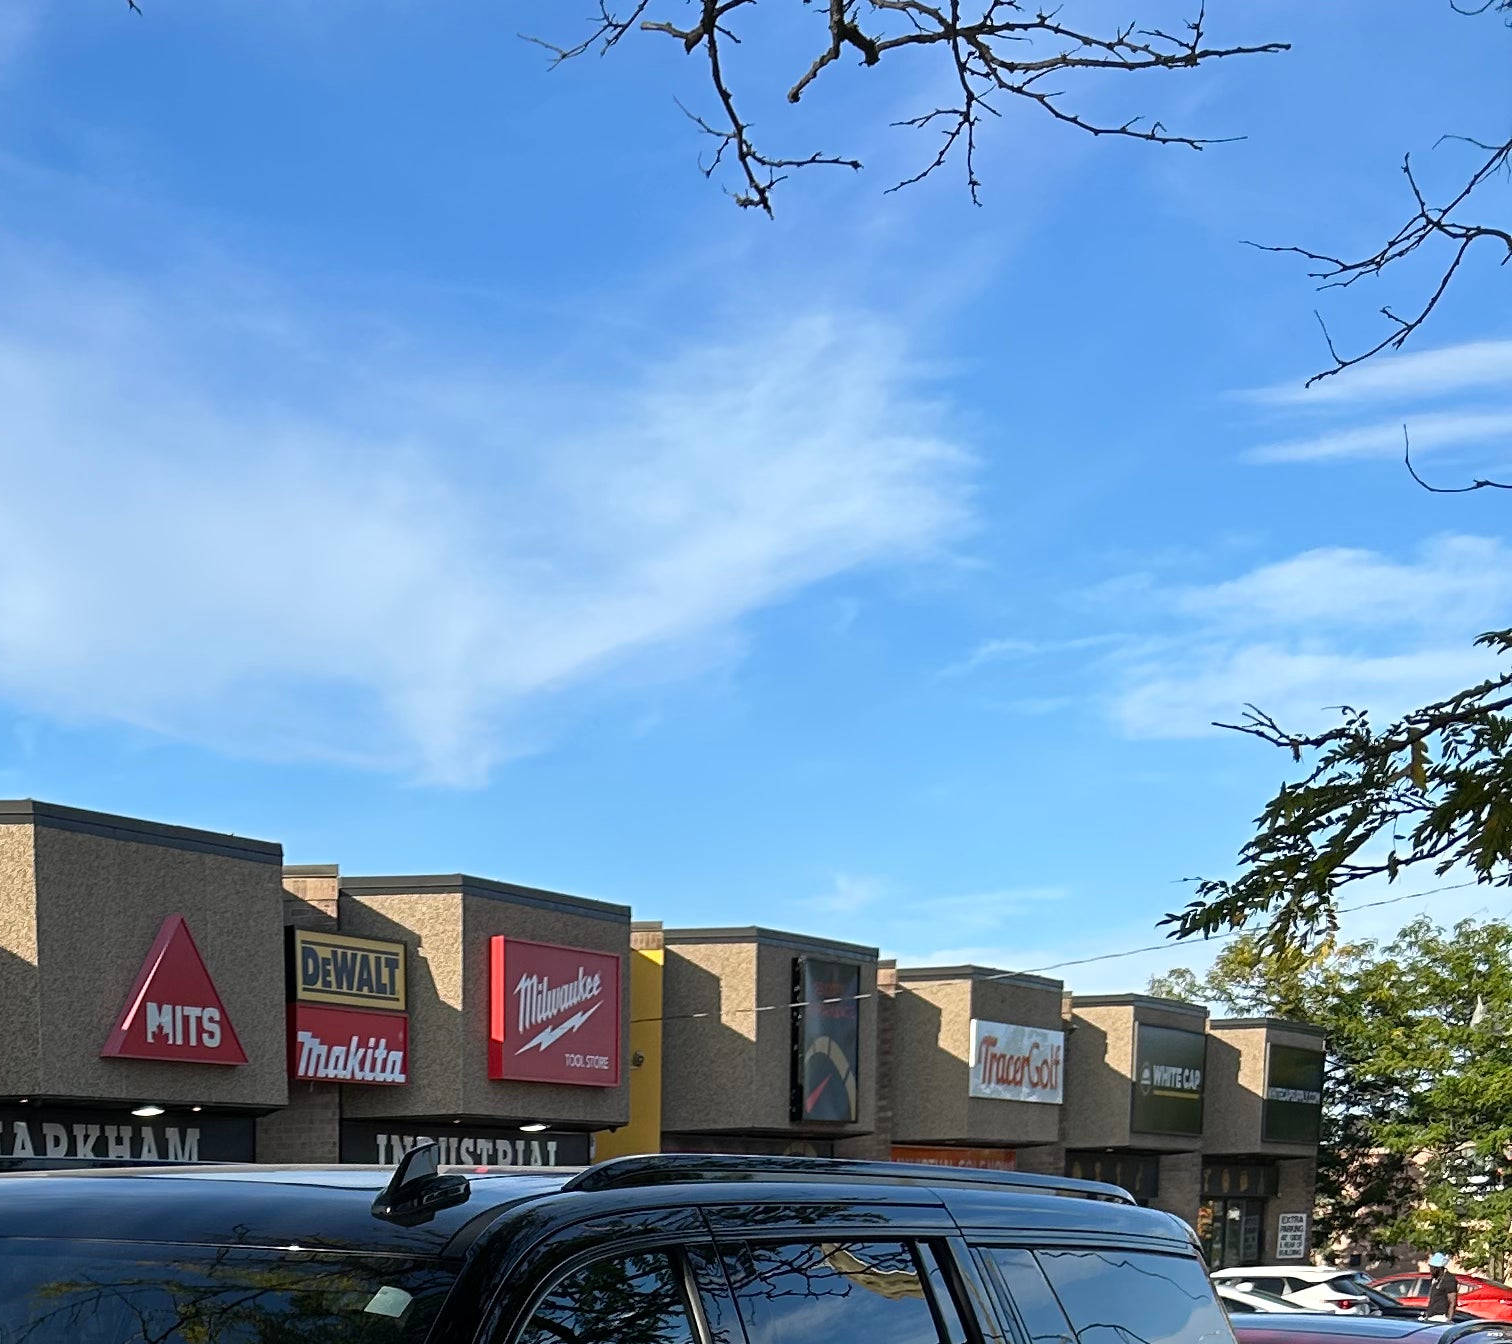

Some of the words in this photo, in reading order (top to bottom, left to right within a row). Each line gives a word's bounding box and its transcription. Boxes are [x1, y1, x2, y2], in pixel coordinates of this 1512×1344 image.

[513, 966, 604, 1035] Milwaukee
[145, 1001, 222, 1048] MITS
[565, 1053, 585, 1069] TOOL
[586, 1054, 610, 1070] STORE
[1152, 1064, 1182, 1088] WHITE
[1182, 1068, 1201, 1090] CAP
[376, 1133, 557, 1166] INUSTRIAL
